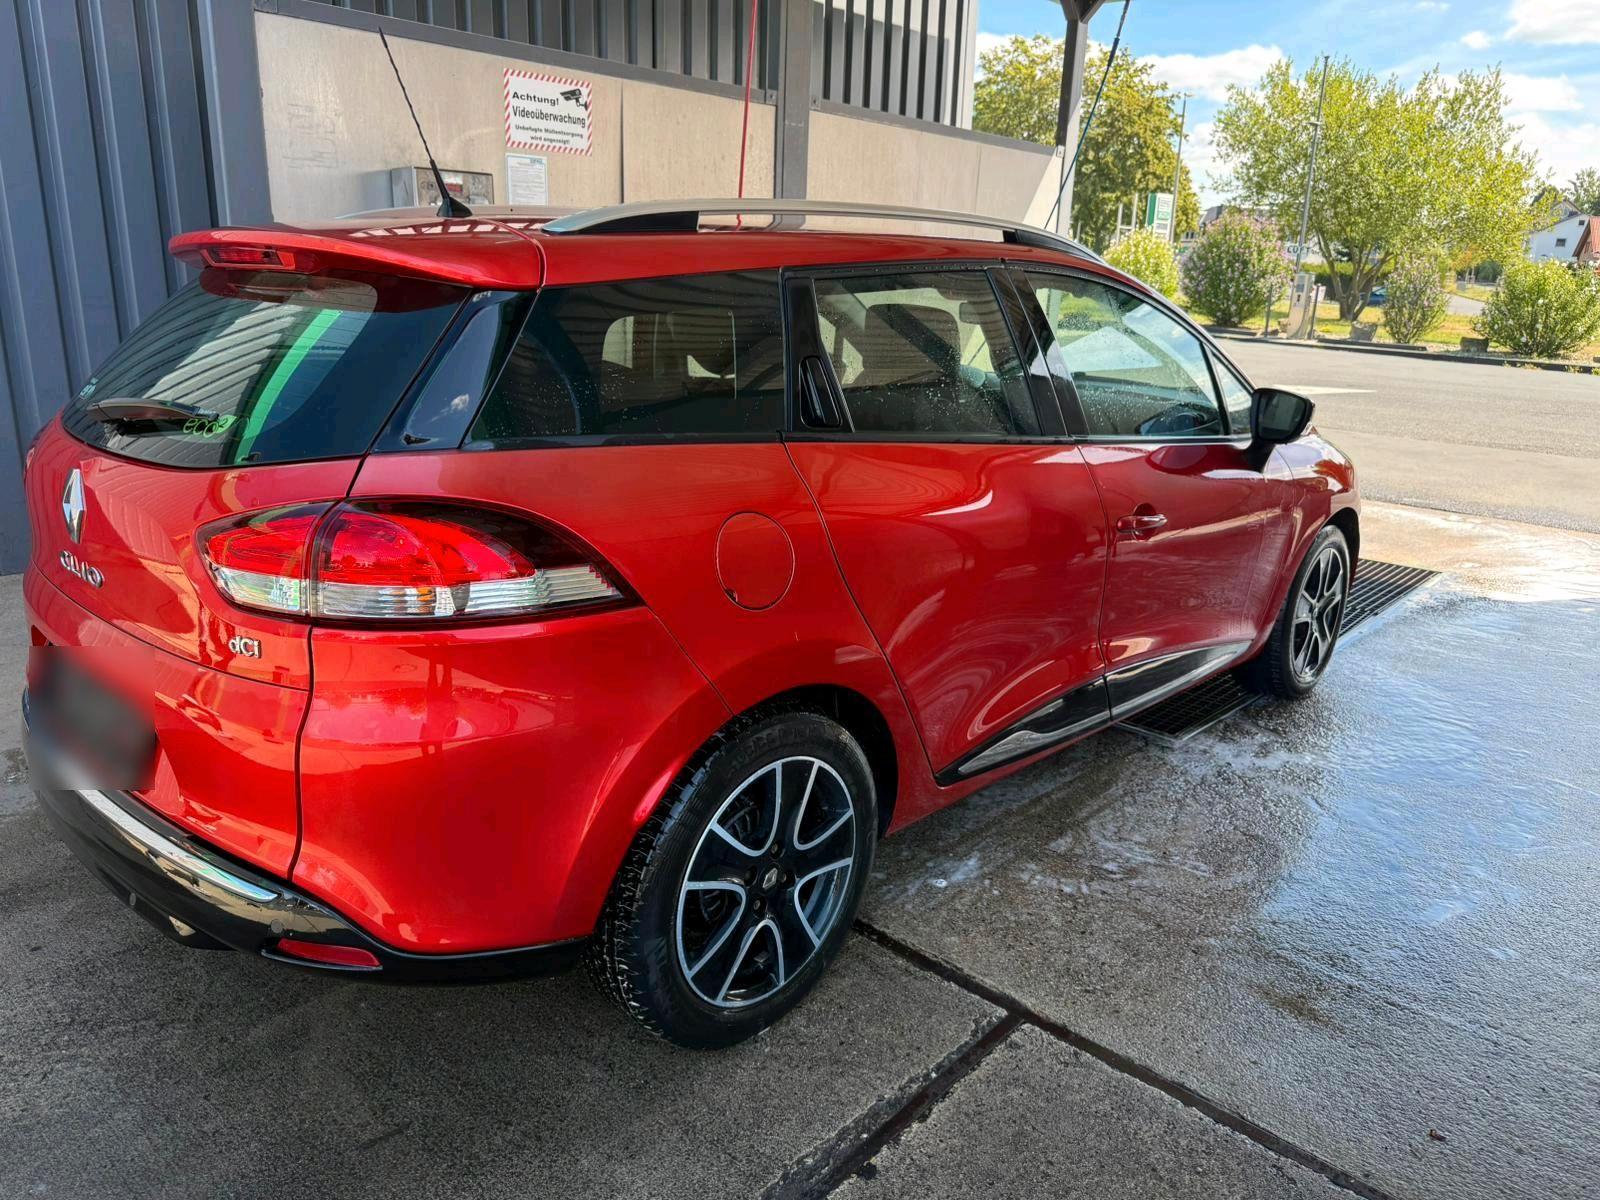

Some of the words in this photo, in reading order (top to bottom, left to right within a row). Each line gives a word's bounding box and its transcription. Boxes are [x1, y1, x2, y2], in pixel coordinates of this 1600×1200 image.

[512, 91, 559, 106] Achtung!
[512, 105, 586, 128] Videoüberwachung
[515, 124, 543, 133] Unbefugte
[60, 550, 104, 588] CLIO
[229, 635, 261, 658] dCi
